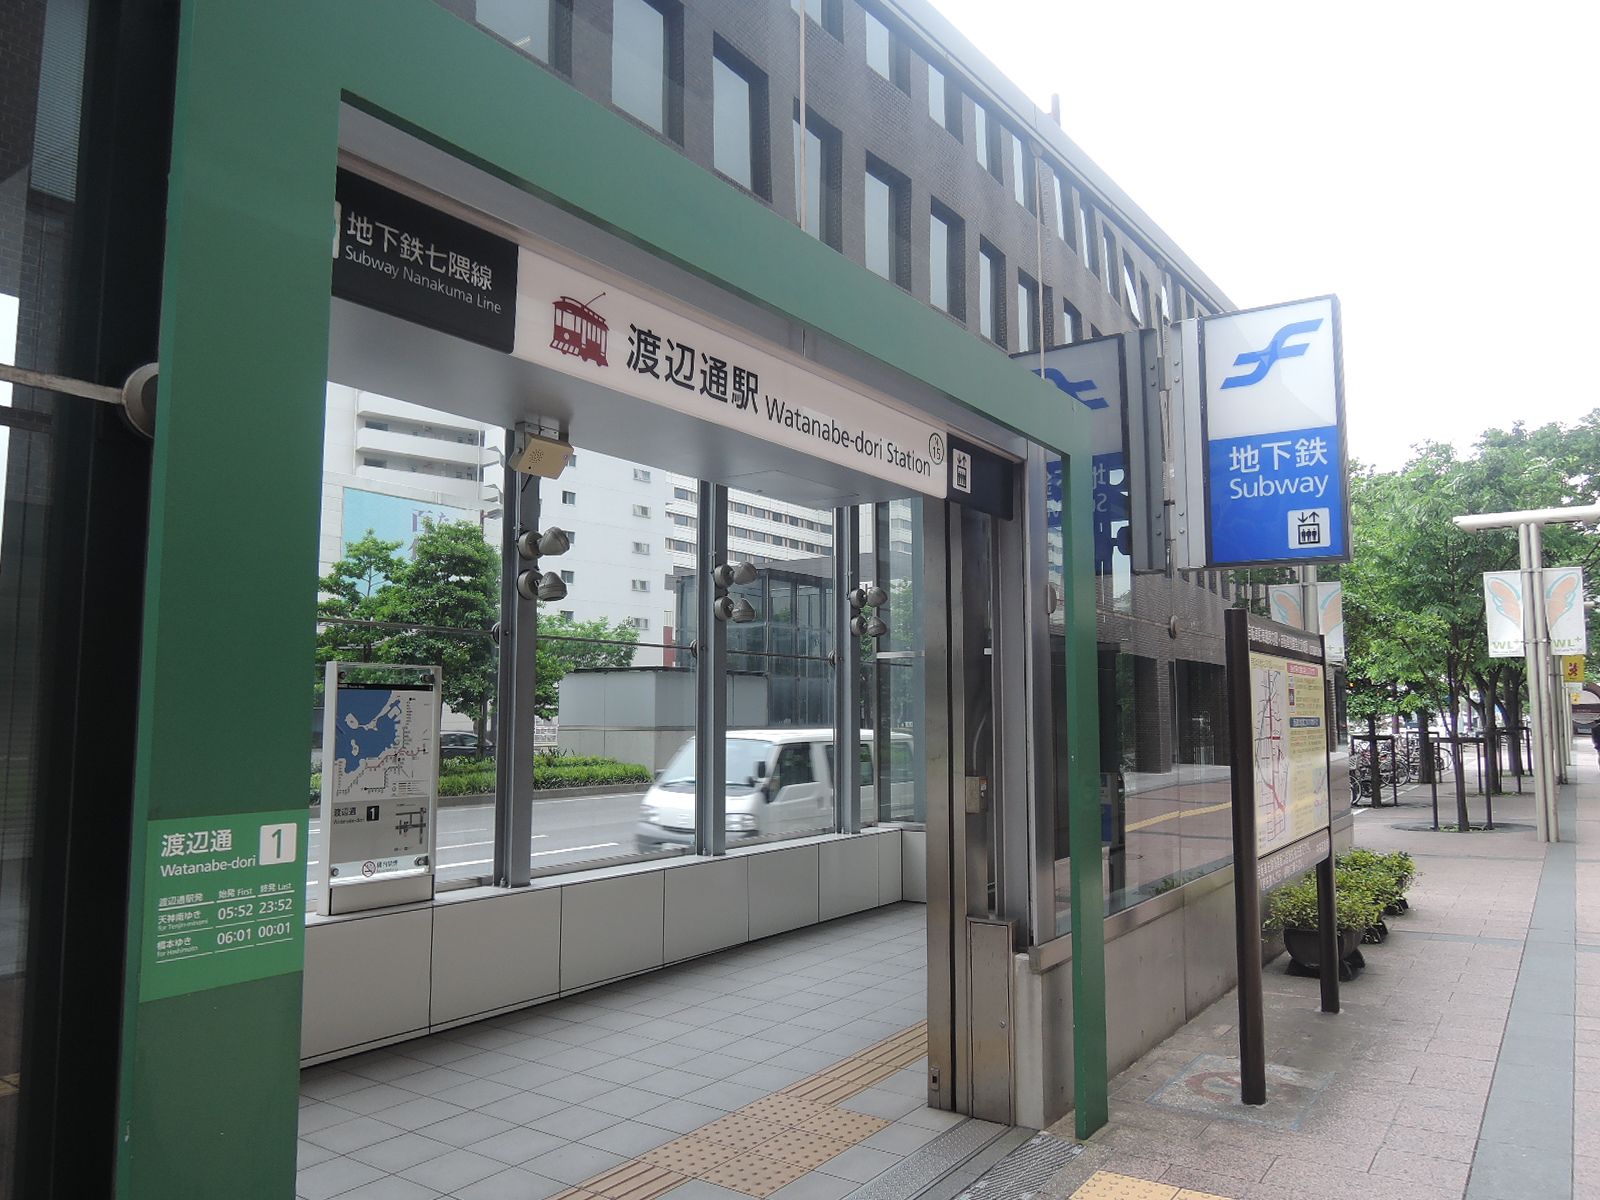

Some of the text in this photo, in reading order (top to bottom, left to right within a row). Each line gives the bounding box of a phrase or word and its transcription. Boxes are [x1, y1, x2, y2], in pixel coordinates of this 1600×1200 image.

[347, 212, 493, 291] 地下鉄七隈線
[345, 245, 502, 315] Subway Nanakuma Line
[626, 323, 759, 415] 渡辺通駅
[765, 395, 931, 477] Watanabe-dori Station
[933, 446, 941, 460] 15
[1229, 436, 1328, 474] 地下鉄
[1229, 474, 1329, 500] Subway
[160, 829, 232, 858] 渡辺通
[271, 828, 283, 859] 1
[160, 855, 257, 877] Watanabe-dori
[218, 888, 253, 900] 始発 First
[278, 882, 292, 891] Last
[218, 904, 253, 920] 05:52
[259, 898, 292, 914] 23:52
[217, 928, 252, 945] 06:01
[258, 922, 290, 938] 00:01
